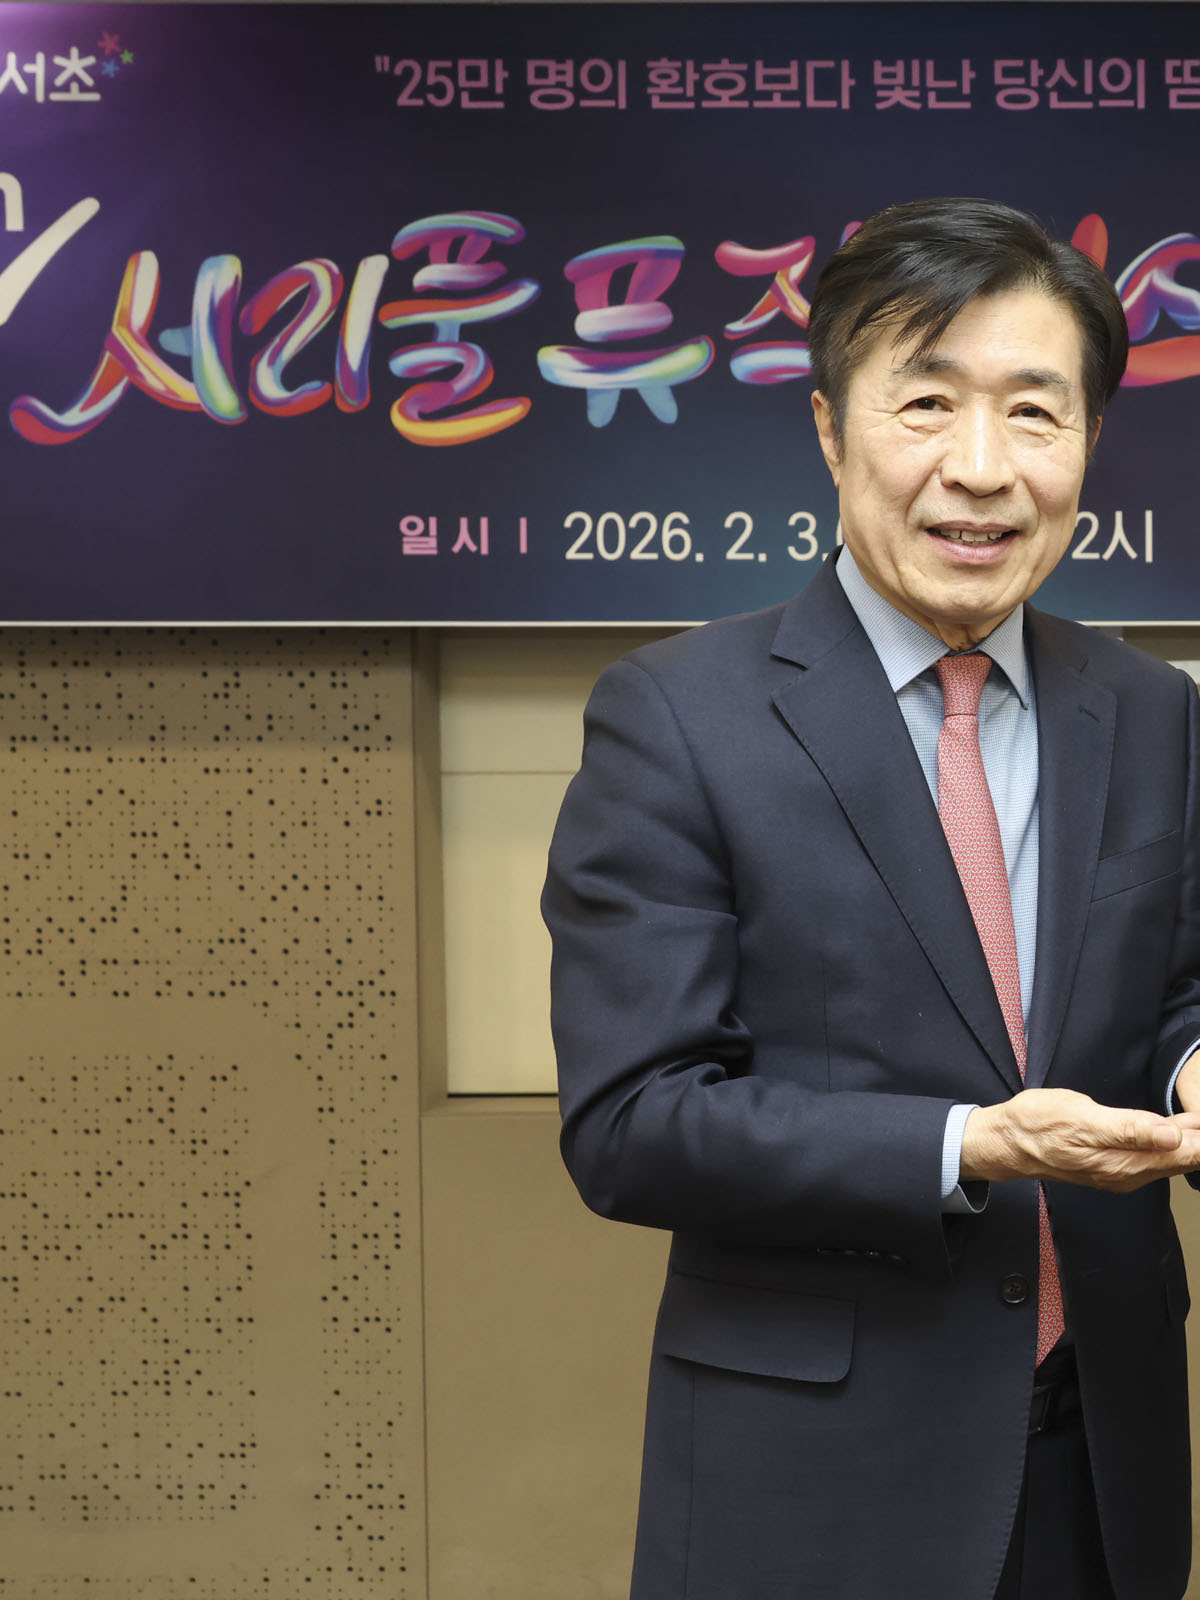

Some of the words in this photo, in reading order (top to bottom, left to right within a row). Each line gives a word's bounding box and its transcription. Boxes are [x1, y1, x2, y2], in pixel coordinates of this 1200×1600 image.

[0, 46, 101, 103] 서초
[376, 56, 507, 108] "25만
[527, 59, 627, 110] 명의
[647, 58, 855, 110] 환호보다
[873, 60, 975, 110] 빛난
[994, 58, 1145, 110] 당신의
[563, 511, 705, 563] 2026.
[723, 511, 767, 563] 2.
